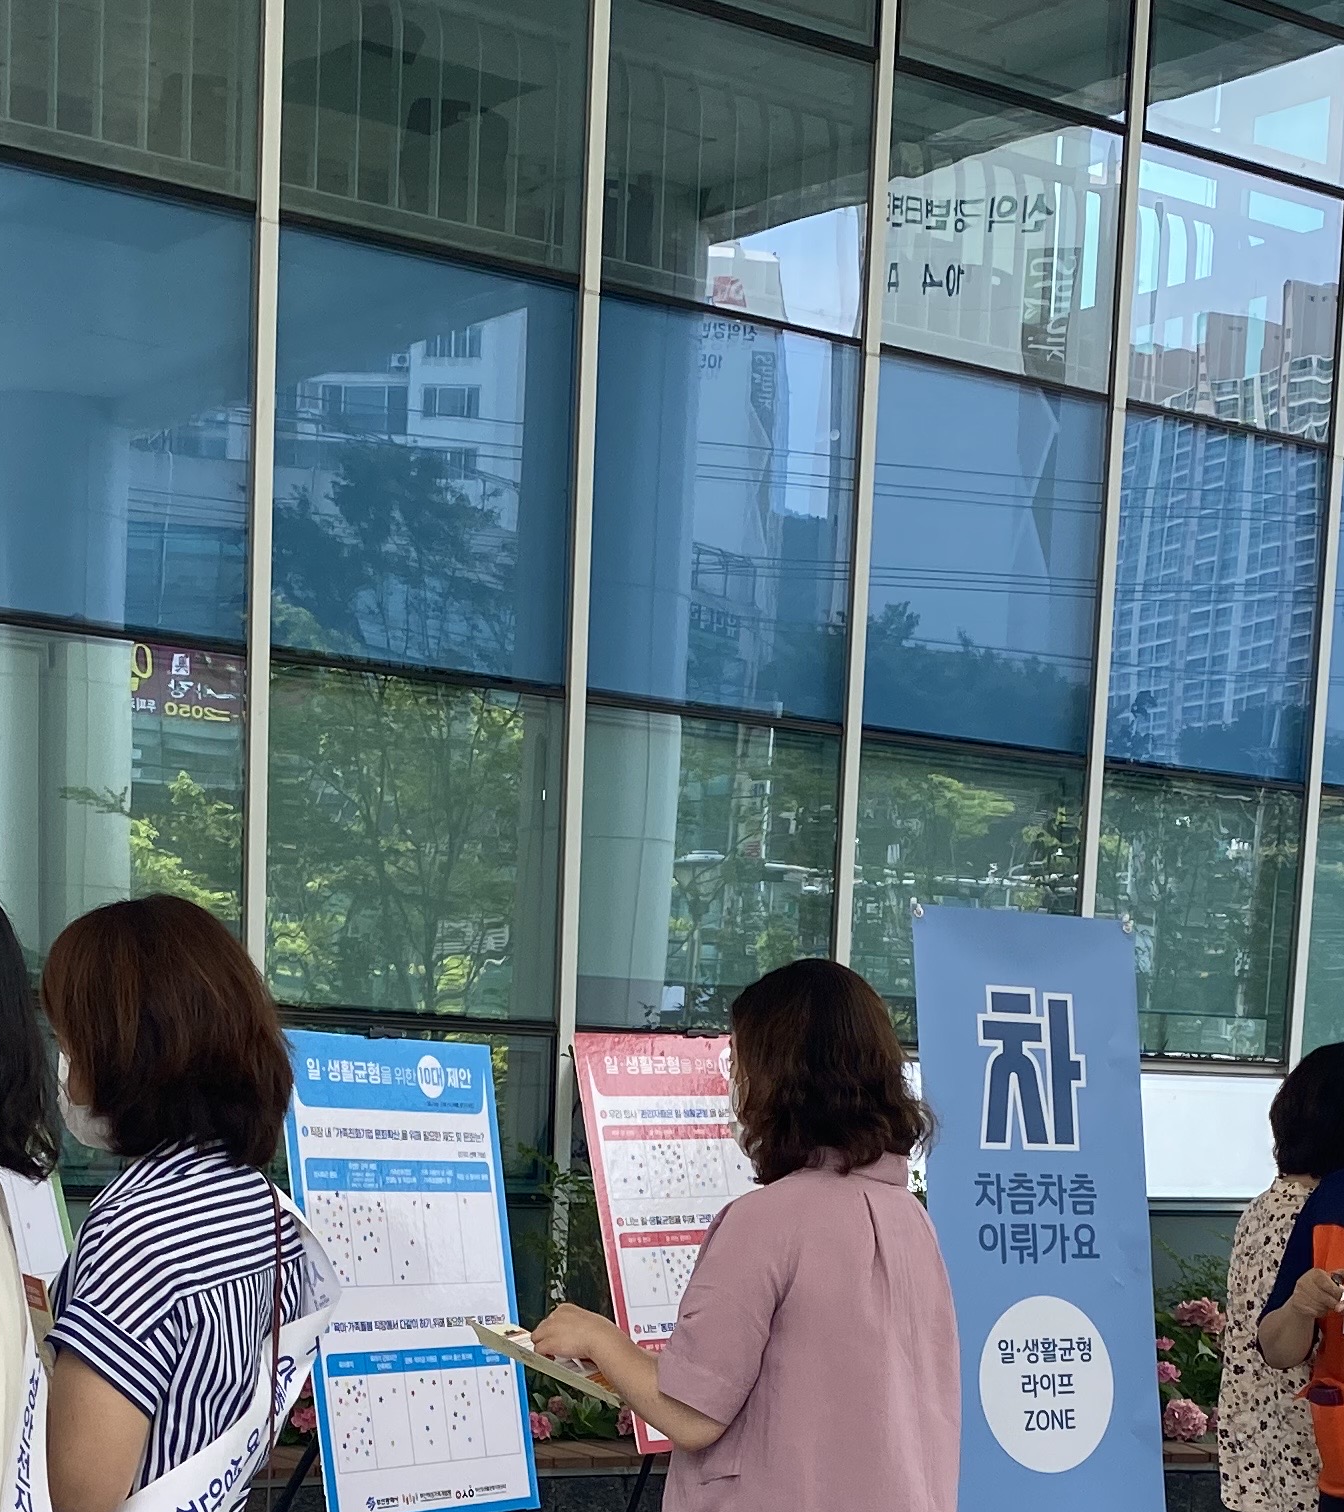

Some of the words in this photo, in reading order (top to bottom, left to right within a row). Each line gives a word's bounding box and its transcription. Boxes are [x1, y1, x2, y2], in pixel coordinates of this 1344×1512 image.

[394, 1067, 416, 1087] 위한
[446, 1067, 472, 1089] 제안
[695, 1058, 718, 1074] 위한
[977, 984, 1086, 1151] 차
[974, 1172, 1097, 1216] 차츰차츰
[978, 1223, 1100, 1264] 이뤄가요
[998, 1337, 1092, 1364] 일·생활균형
[1021, 1374, 1075, 1398] 라이프
[1024, 1409, 1076, 1431] ZONE
